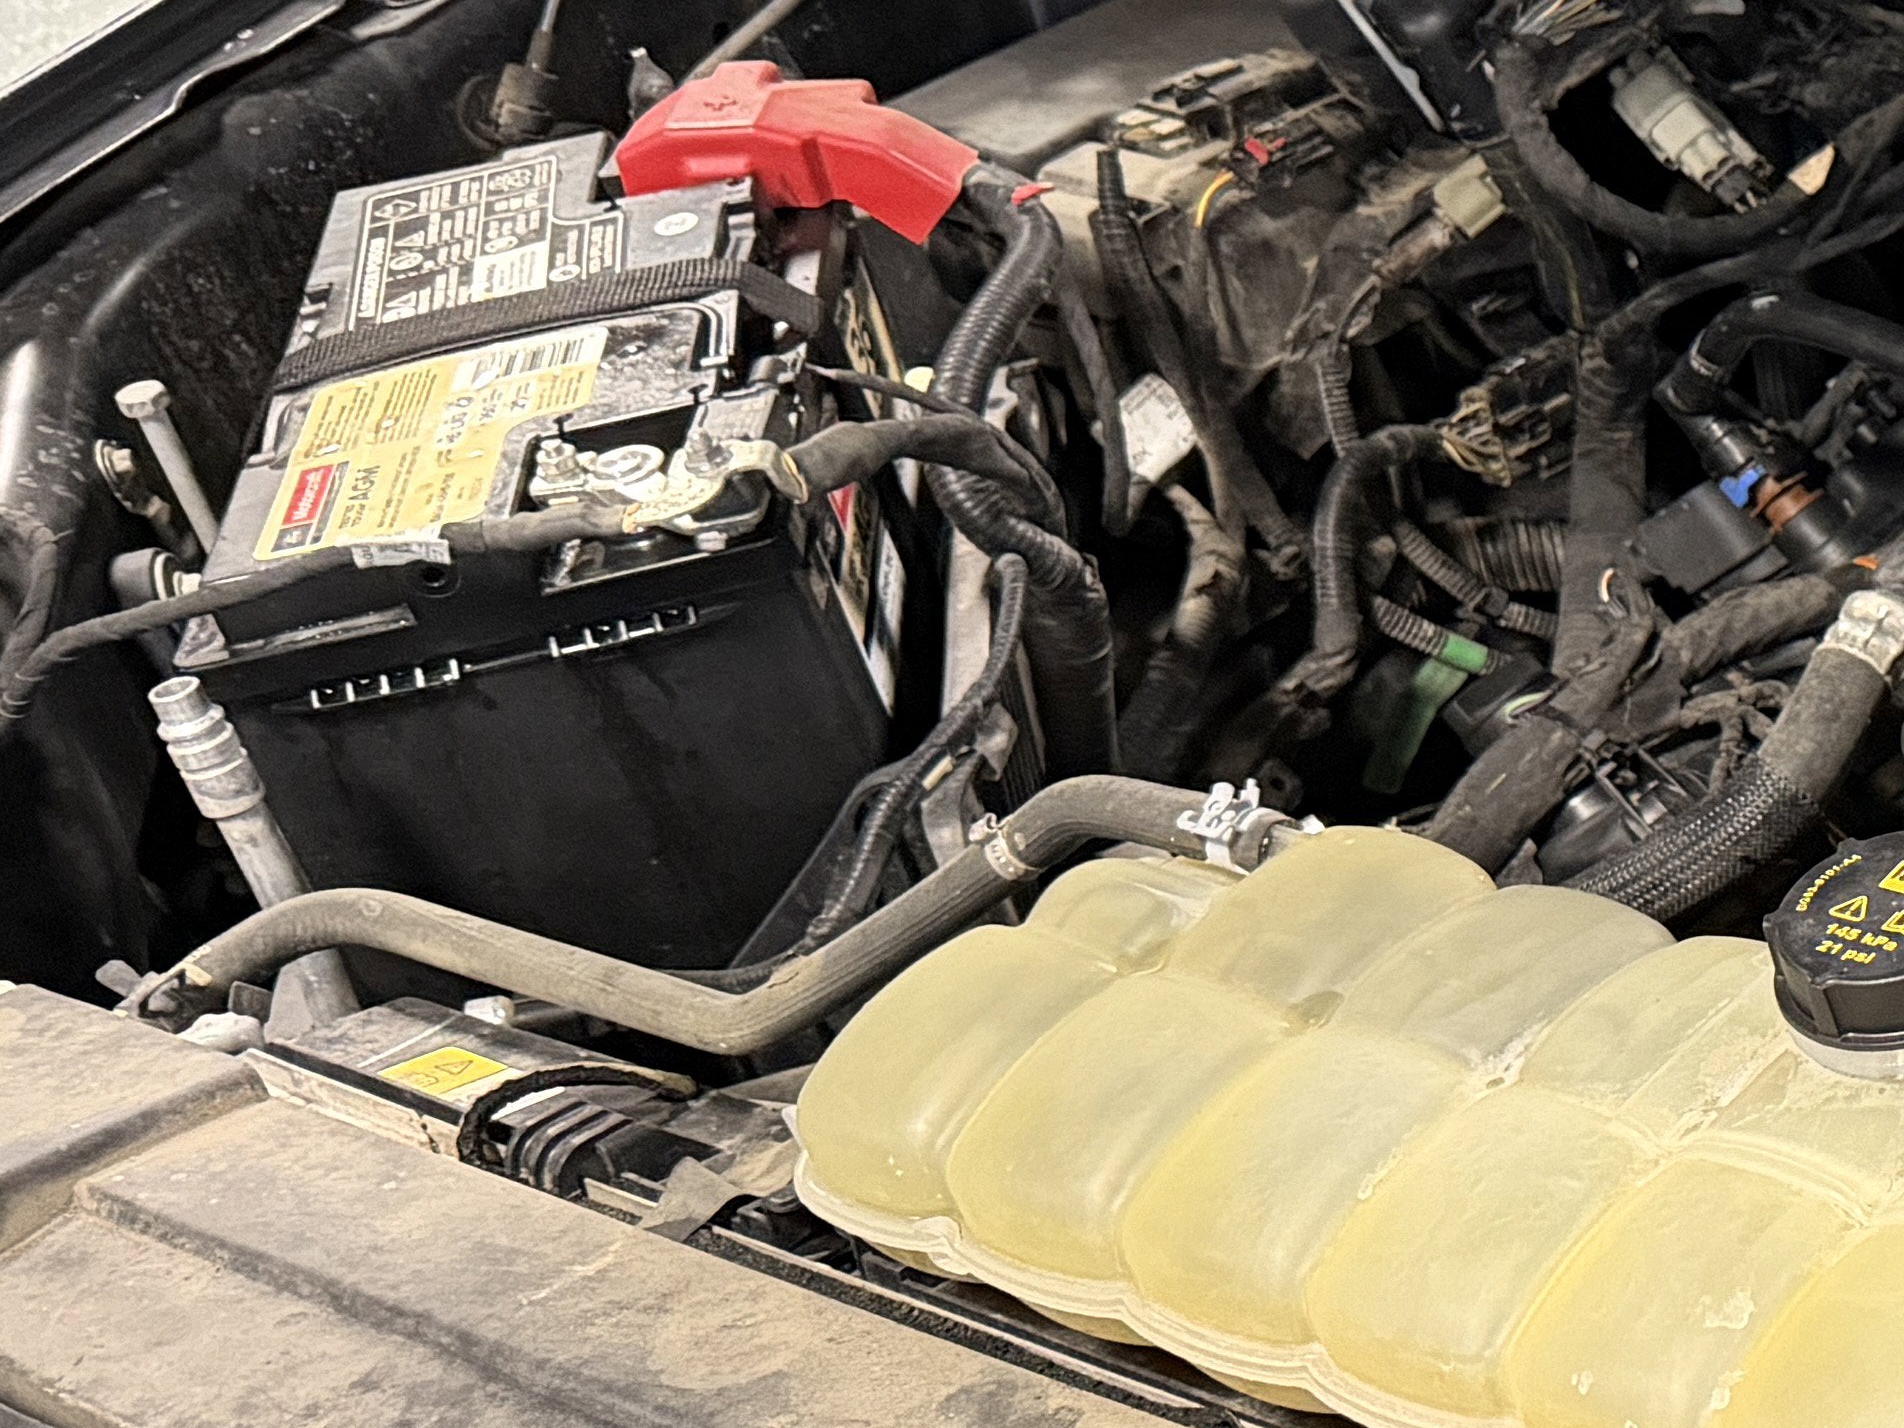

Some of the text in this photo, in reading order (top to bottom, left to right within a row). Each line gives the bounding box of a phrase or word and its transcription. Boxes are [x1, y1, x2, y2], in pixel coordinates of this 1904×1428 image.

[350, 464, 381, 502] AGM
[1826, 923, 1898, 951] 145 kPa
[1815, 940, 1876, 964] 21 psi
